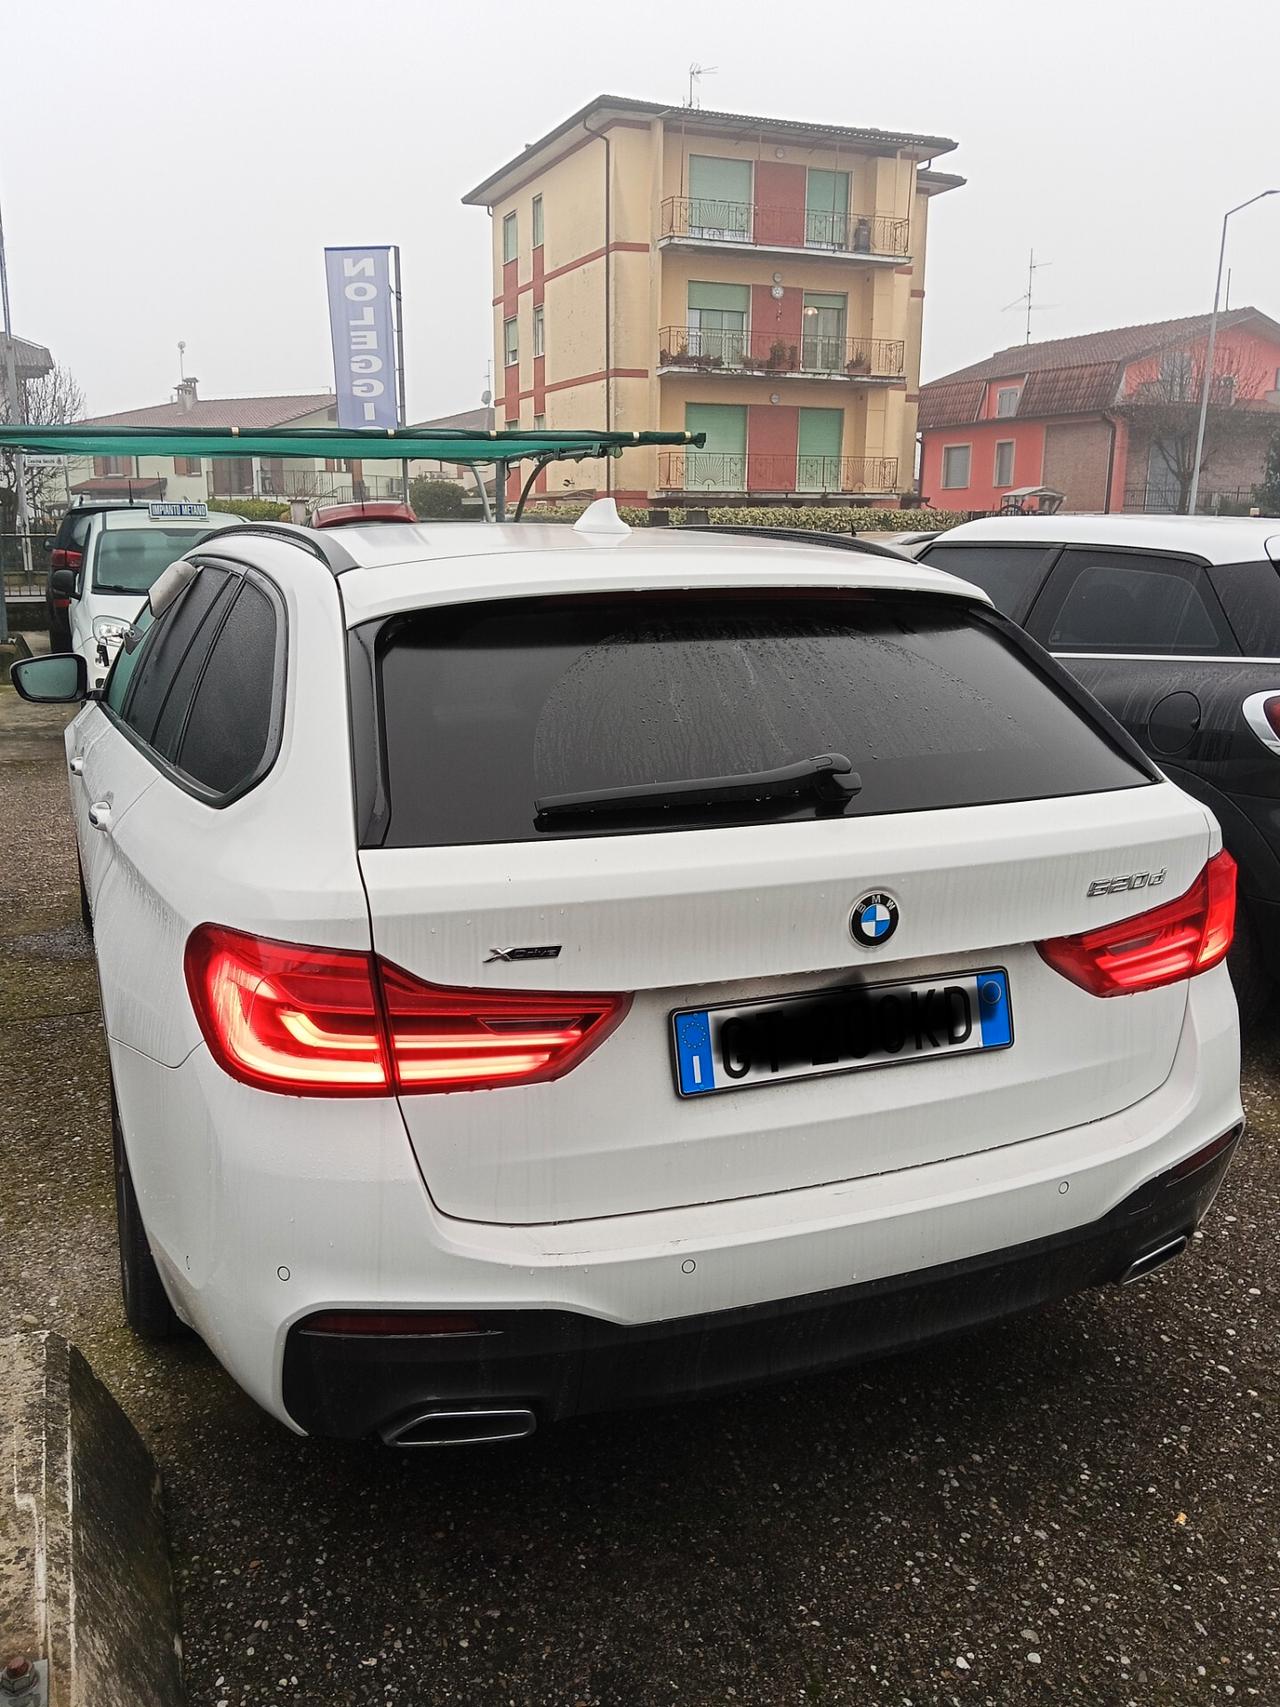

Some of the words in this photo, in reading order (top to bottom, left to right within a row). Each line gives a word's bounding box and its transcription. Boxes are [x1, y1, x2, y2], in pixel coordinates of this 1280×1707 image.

[151, 504, 181, 516] IMPIANTO
[181, 504, 207, 516] METANO
[856, 895, 896, 913] BMW
